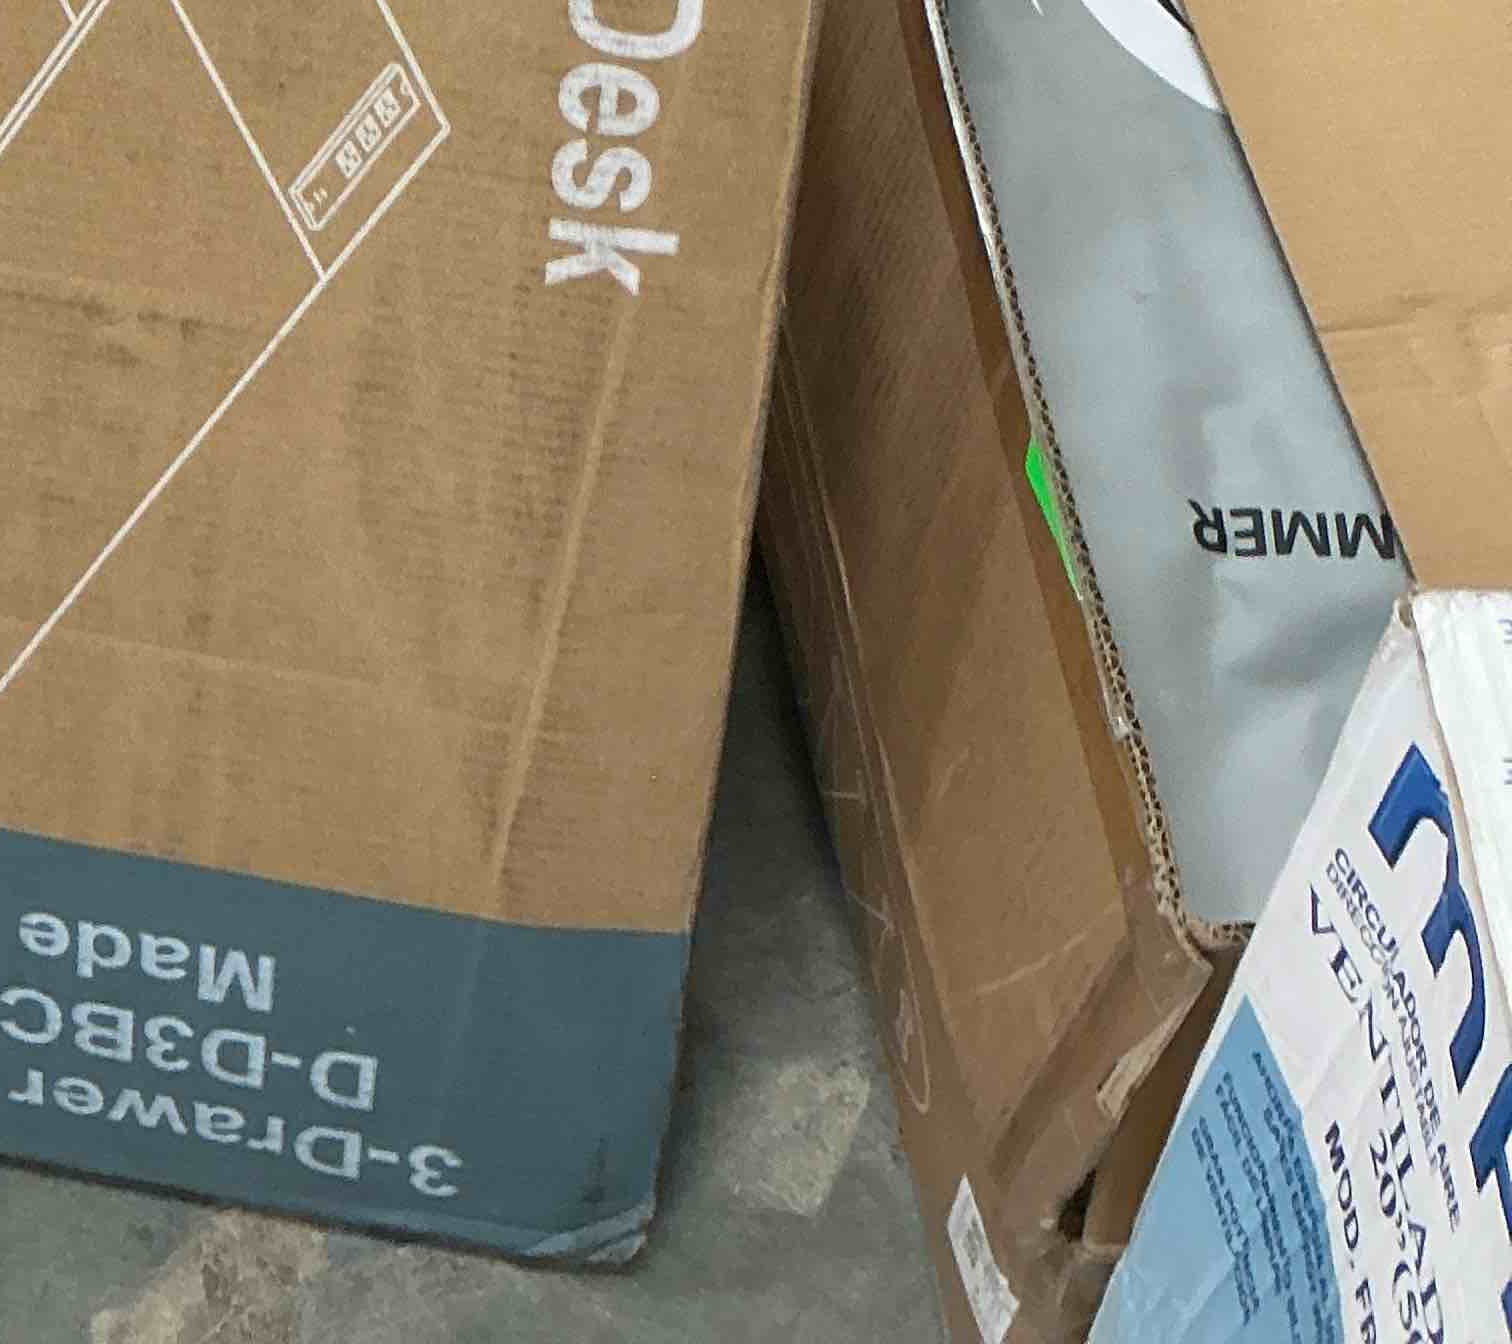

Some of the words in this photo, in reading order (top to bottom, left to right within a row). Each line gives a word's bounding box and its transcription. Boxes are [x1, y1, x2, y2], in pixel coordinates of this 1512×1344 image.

[17, 911, 277, 1013] Made
[7, 1067, 464, 1198] 3-Drawer
[1324, 1119, 1360, 1272] MOD.
[1422, 1078, 1442, 1138] DE
[1437, 1142, 1461, 1234] AIRE
